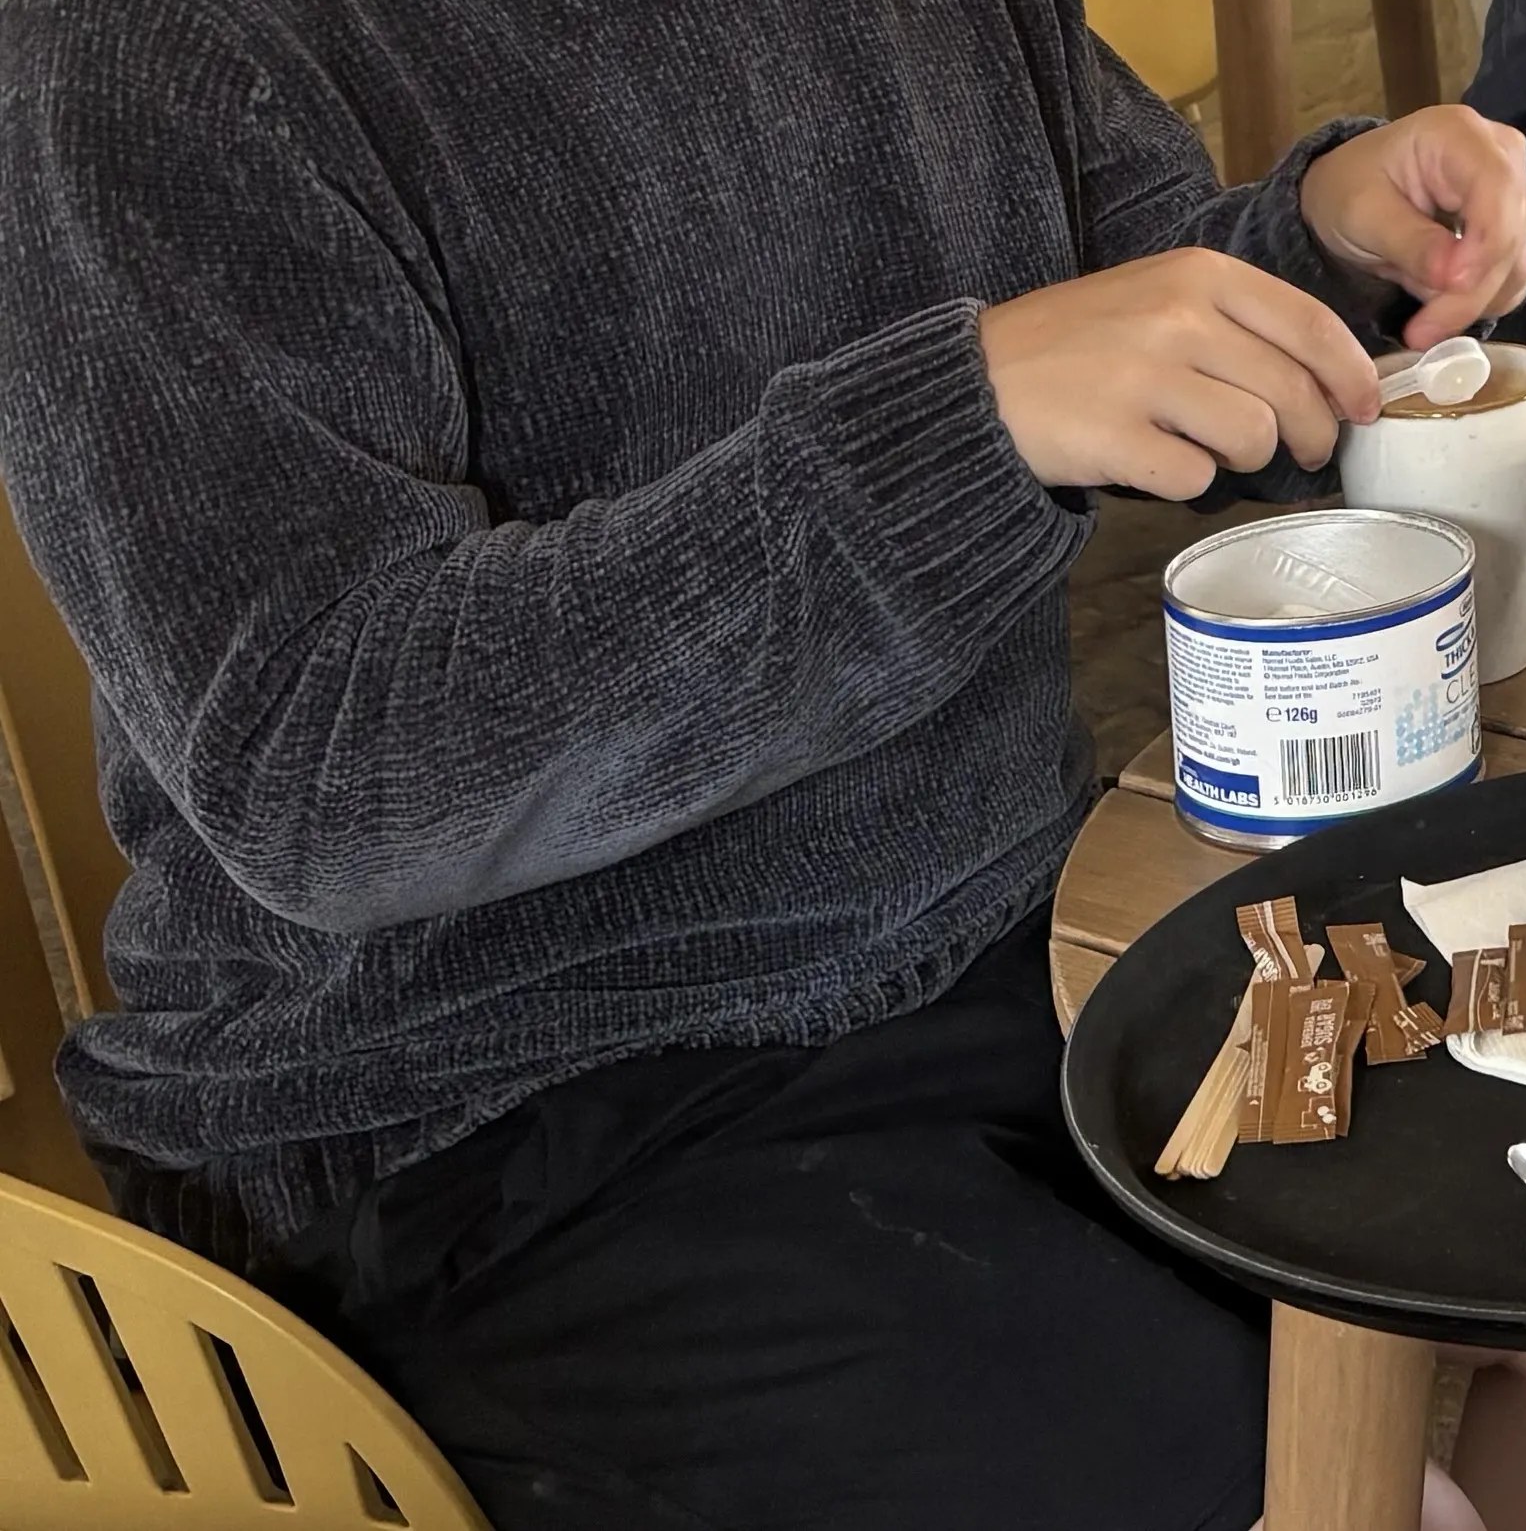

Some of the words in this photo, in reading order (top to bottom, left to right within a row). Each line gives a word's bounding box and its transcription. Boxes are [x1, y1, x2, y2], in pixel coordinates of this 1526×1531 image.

[1285, 707, 1318, 724] 126g
[1253, 947, 1278, 982] UGAR
[1314, 1012, 1336, 1046] SUGAR
